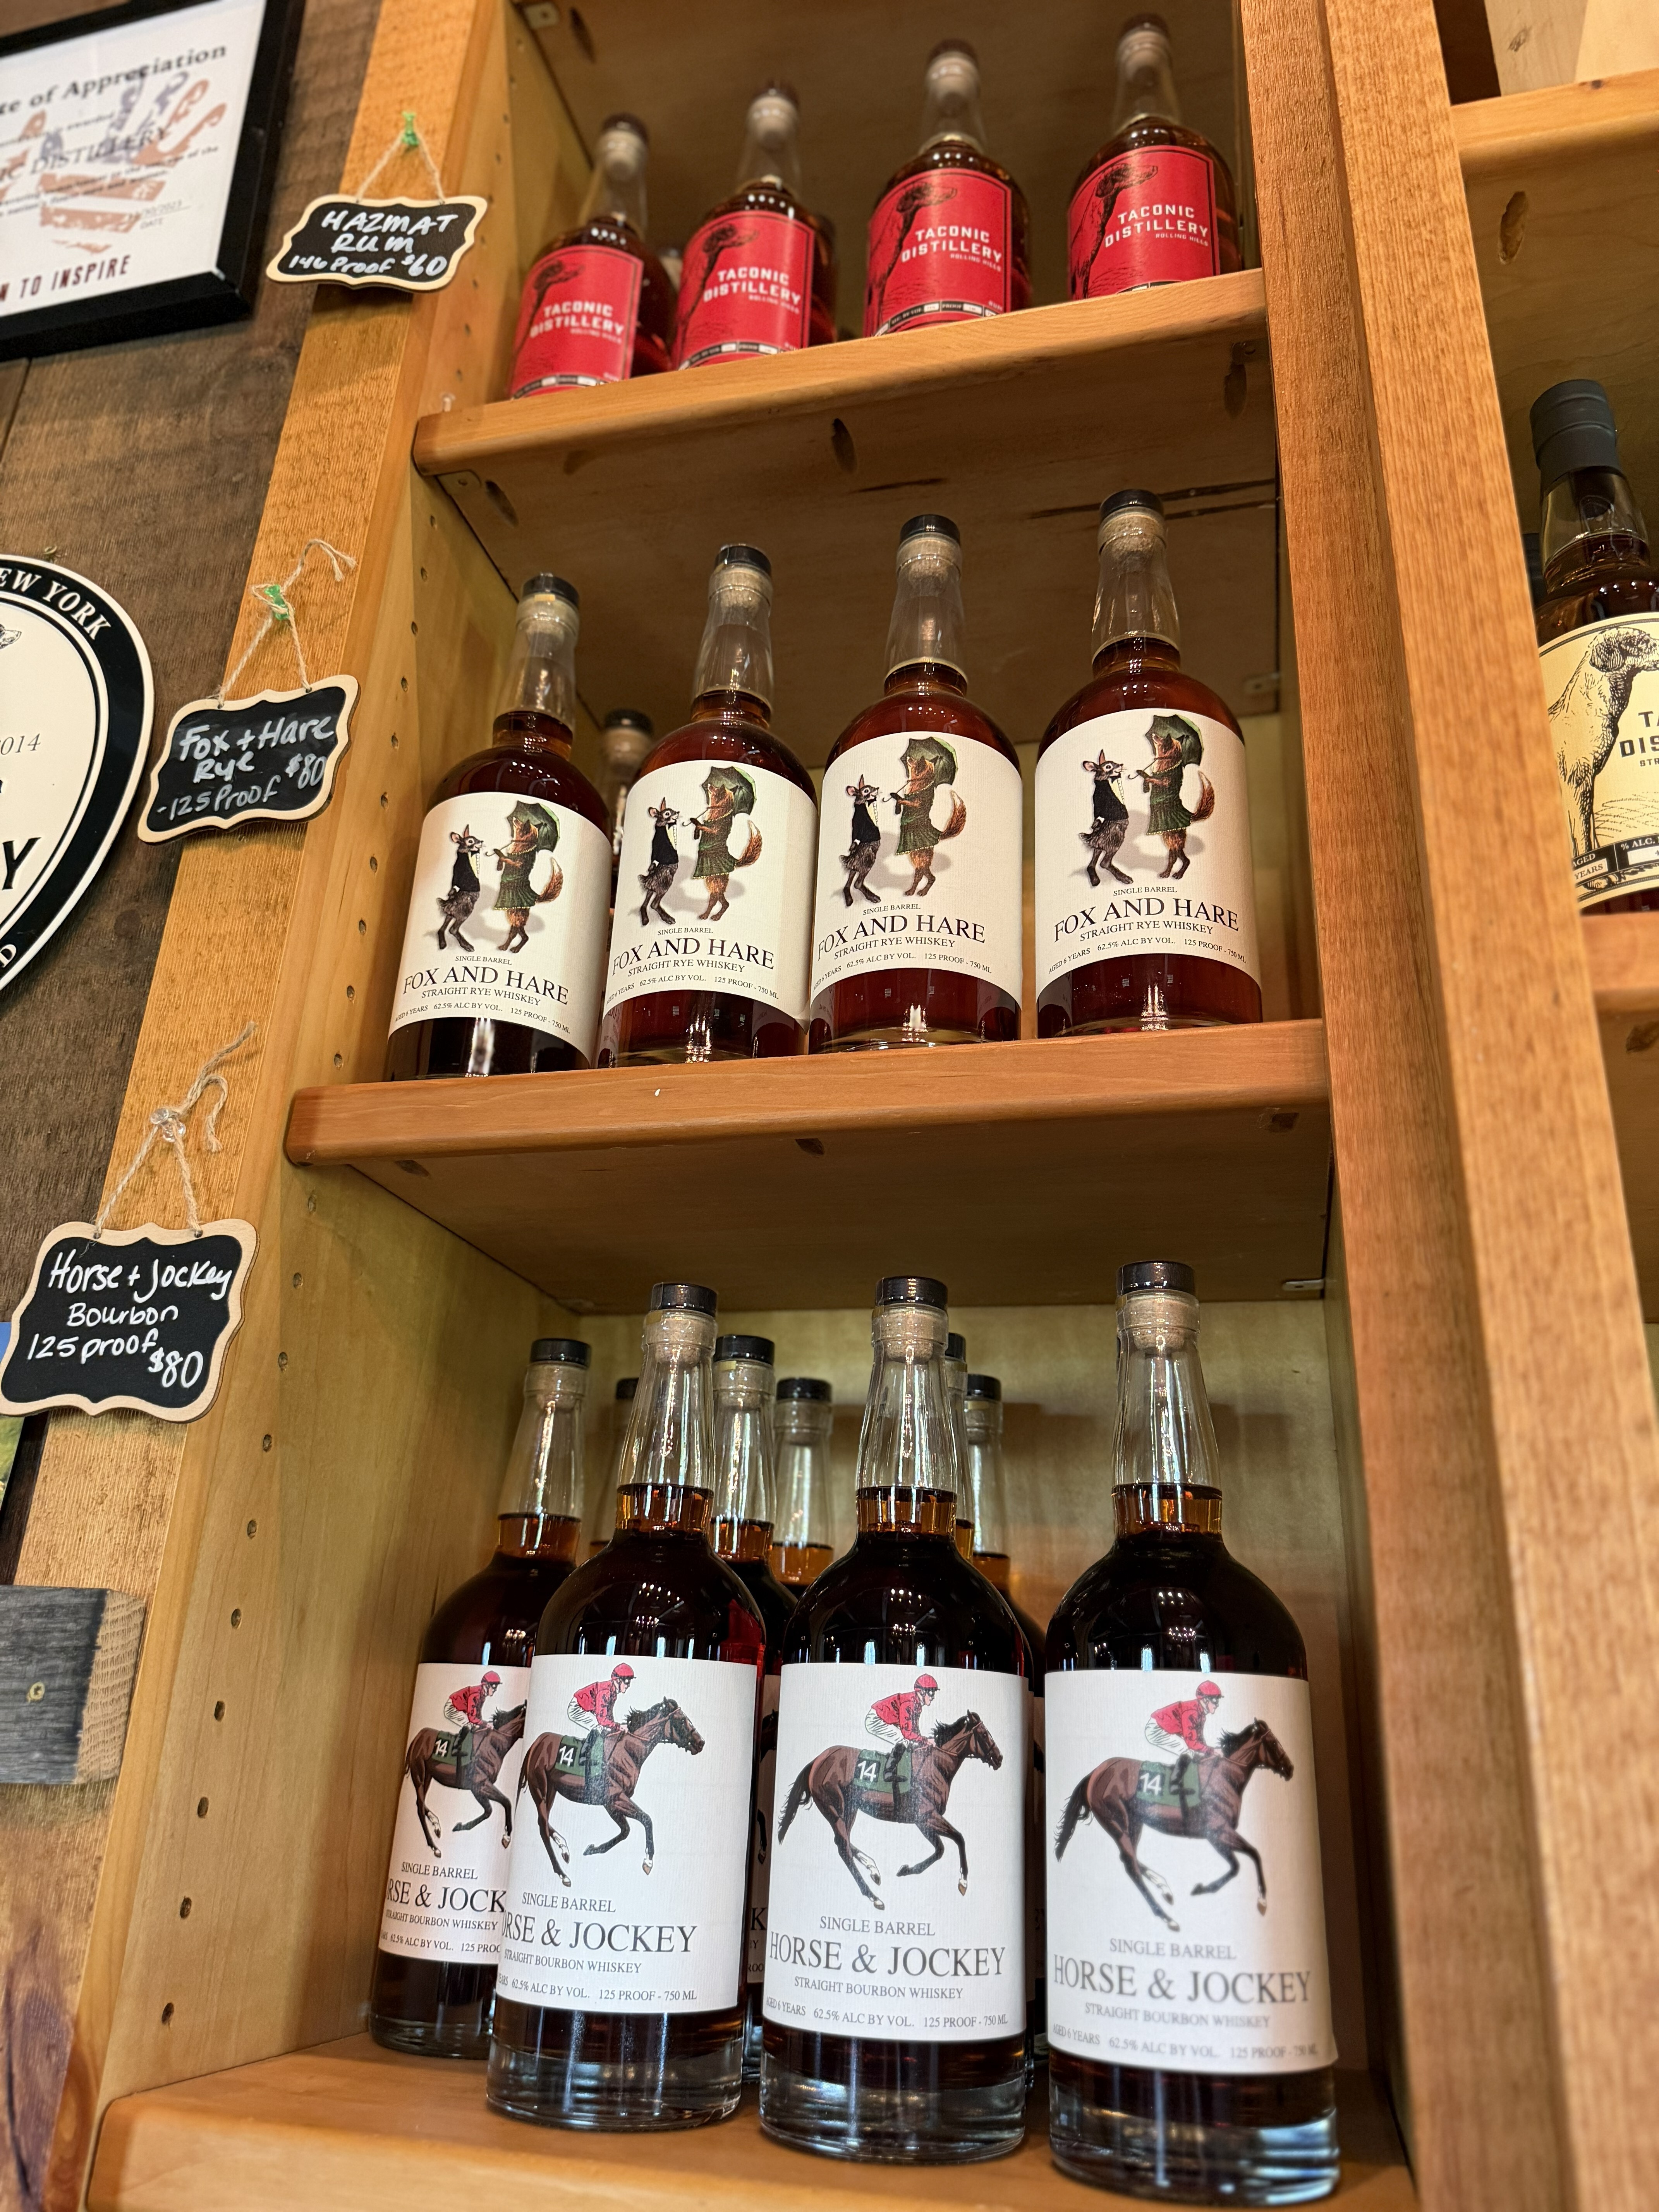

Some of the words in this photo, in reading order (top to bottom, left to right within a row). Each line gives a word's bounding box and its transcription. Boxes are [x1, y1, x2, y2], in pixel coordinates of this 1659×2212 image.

[29, 84, 58, 108] of
[62, 45, 227, 98] Appreciation
[321, 210, 458, 235] HAZMAT
[1118, 204, 1194, 224] TACONIC
[331, 233, 414, 253] RUM
[915, 225, 989, 243] TACONIC
[1104, 219, 1208, 248] DISTILLERY
[1189, 236, 1208, 246] HILLS
[901, 240, 1002, 263] DISTILLERY
[20, 275, 41, 299] TO
[51, 254, 130, 290] INSPIRE
[289, 255, 328, 269] 146
[330, 257, 395, 273] Proof
[401, 254, 447, 276] $60
[717, 267, 789, 285] TACONIC
[703, 282, 801, 305] DISTILLERY
[544, 301, 613, 318] TACONIC
[529, 315, 624, 338] DISTILLERY
[0, 568, 42, 592] EW
[43, 580, 111, 640] YORK
[0, 733, 41, 755] 014
[179, 725, 230, 761] Fox
[193, 751, 254, 783] Rye
[285, 753, 327, 789] $80
[1632, 838, 1655, 848] ALC.
[1572, 853, 1595, 868] AGED
[1574, 864, 1603, 879] YEARS
[1113, 887, 1142, 896] SINGLE
[863, 905, 888, 915] SINGLE
[1054, 906, 1097, 943] FOX
[1103, 898, 1164, 923] AND
[1173, 898, 1239, 933] HARE
[658, 927, 682, 936] SINGLE
[817, 926, 848, 961] FOX
[852, 915, 908, 940] AND
[915, 914, 985, 943] HARE
[1080, 922, 1134, 942] STRAIGHT
[1137, 921, 1160, 929] RYE
[1163, 921, 1213, 934] WHISKEY
[612, 945, 643, 976] FOX
[647, 938, 700, 959] AND
[706, 938, 774, 971] HARE
[834, 939, 879, 960] STRAIGHT
[881, 937, 902, 946] RYE
[905, 937, 955, 948] WHISKEY
[1048, 961, 1063, 974] AGED
[1068, 948, 1091, 962] YEARS
[1097, 941, 1119, 951] 62.5%
[1120, 938, 1139, 946] ALC
[1198, 941, 1223, 952] PROOF
[1227, 949, 1237, 958] 750
[483, 957, 512, 965] BARREL
[628, 960, 672, 977] STRAIGHT
[696, 959, 745, 972] WHISKEY
[866, 955, 882, 963] ALC
[939, 954, 965, 964] PROOF
[970, 960, 981, 969] 750
[403, 968, 440, 994] FOX
[442, 966, 498, 983] AND
[505, 970, 568, 1006] HARE
[421, 987, 469, 998] STRAIGHT
[470, 987, 491, 996] RYE
[494, 989, 541, 1006] WHISKEY
[728, 978, 753, 989] PROOF
[758, 986, 768, 994] 750
[524, 1010, 547, 1022] PROOF
[552, 1020, 562, 1029] 750
[48, 1249, 123, 1293] Horse
[67, 1303, 179, 1327] Bourbon
[27, 1333, 79, 1360] 125
[81, 1328, 159, 1364] proof
[147, 1347, 204, 1388] $80
[434, 1740, 448, 1757] 14
[559, 1745, 574, 1766] 14
[857, 1760, 878, 1781] 14
[1139, 1772, 1162, 1795] 14
[401, 1861, 430, 1875] SINGLE
[431, 1865, 478, 1879] BARREL
[415, 1884, 432, 1908] &
[522, 1892, 558, 1908] SINGLE
[560, 1896, 616, 1913] BARREL
[409, 1914, 450, 1927] BOURBON
[452, 1919, 498, 1931] WHISKEY
[502, 1910, 535, 1943] ORSE
[541, 1919, 561, 1947] &
[569, 1922, 697, 1953] JOCKEY
[820, 1915, 870, 1933] SINGLE
[874, 1920, 936, 1936] BARREL
[504, 1948, 534, 1965] STRAIGHT
[534, 1955, 584, 1970] BOURBON
[587, 1961, 642, 1973] WHISKEY
[769, 1931, 842, 1970] HORSE
[852, 1944, 878, 1974] &
[887, 1946, 1005, 1977] JOCKEY
[1109, 1938, 1165, 1956] SINGLE
[1170, 1943, 1237, 1960] BARREL
[512, 1978, 529, 1991] 62.5%
[530, 1982, 548, 1994] ALC
[549, 1985, 563, 1996] BY
[567, 1987, 590, 1999] VOL.
[599, 1989, 615, 2000] 125
[618, 1990, 656, 2001] PROOF
[664, 1990, 680, 2001] 750
[682, 1990, 697, 2000] ML
[794, 1976, 843, 1993] STRAIGHT
[845, 1983, 906, 1997] BOURBON
[909, 1987, 963, 1999] WHISKEY
[1054, 1954, 1137, 1996] HORSE
[1148, 1968, 1175, 2001] &
[1188, 1972, 1310, 2004] JOCKEY
[782, 2001, 806, 2016] YEARS
[814, 2008, 840, 2021] 62.5%
[842, 2012, 865, 2024] ALC
[867, 2014, 884, 2025] BY
[888, 2016, 914, 2027] VOL.
[924, 2017, 940, 2028] 125
[943, 2016, 977, 2028] PROOF
[984, 2015, 996, 2026] 750
[997, 2013, 1008, 2025] ML
[1085, 2002, 1140, 2020] STRAIGHT
[1143, 2009, 1209, 2026] BOURBON
[1213, 2016, 1270, 2027] WHISKEY
